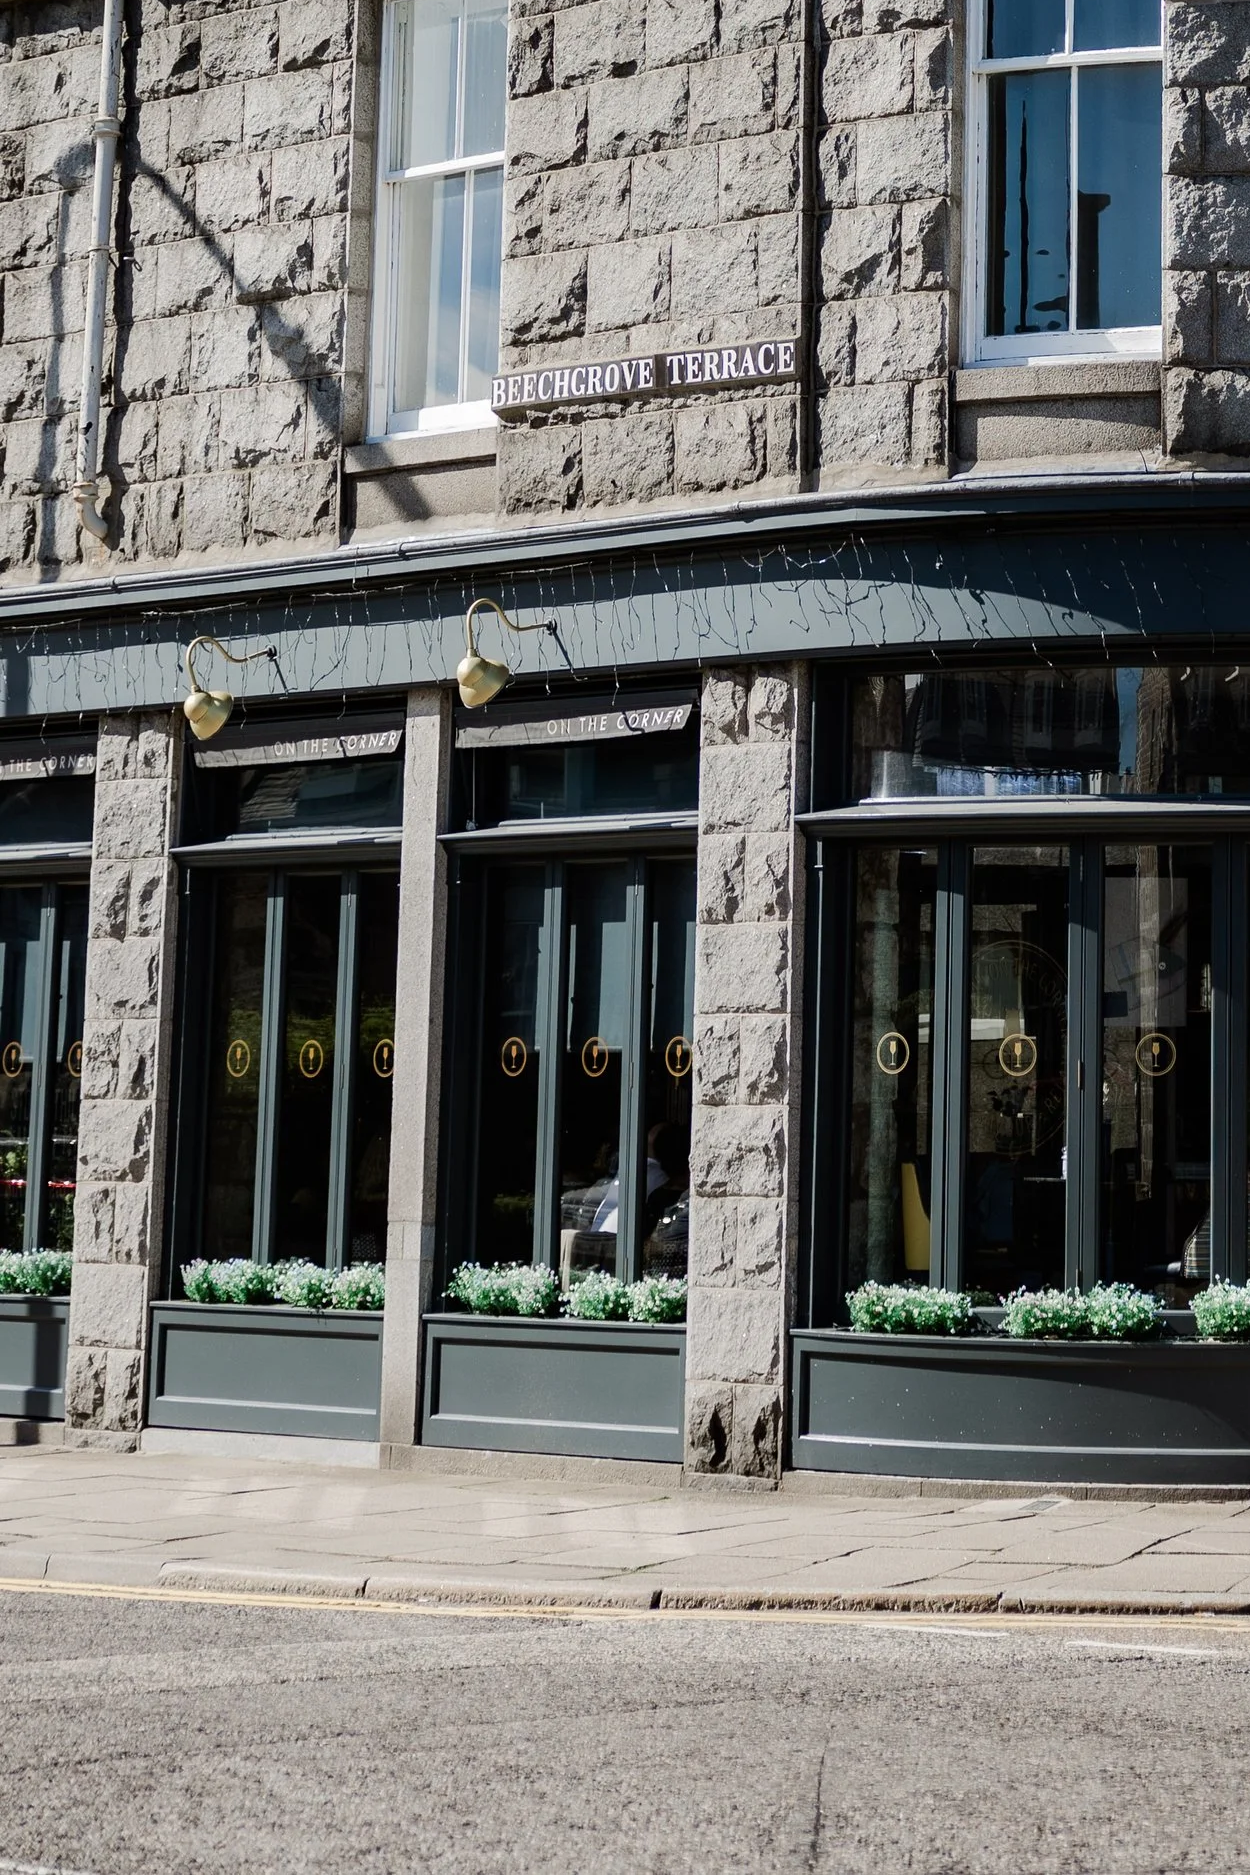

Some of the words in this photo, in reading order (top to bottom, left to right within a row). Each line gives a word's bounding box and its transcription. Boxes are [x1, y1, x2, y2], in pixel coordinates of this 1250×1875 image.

[492, 358, 654, 407] BEECHGROVE
[666, 342, 795, 385] TERRACE
[546, 719, 571, 735] ON
[580, 715, 608, 732] THE
[616, 708, 685, 730] CORNER
[274, 741, 296, 757] ON
[302, 738, 329, 754] THE
[336, 732, 397, 751] CORNER
[9, 758, 33, 773] THE
[40, 753, 94, 771] CORNER
